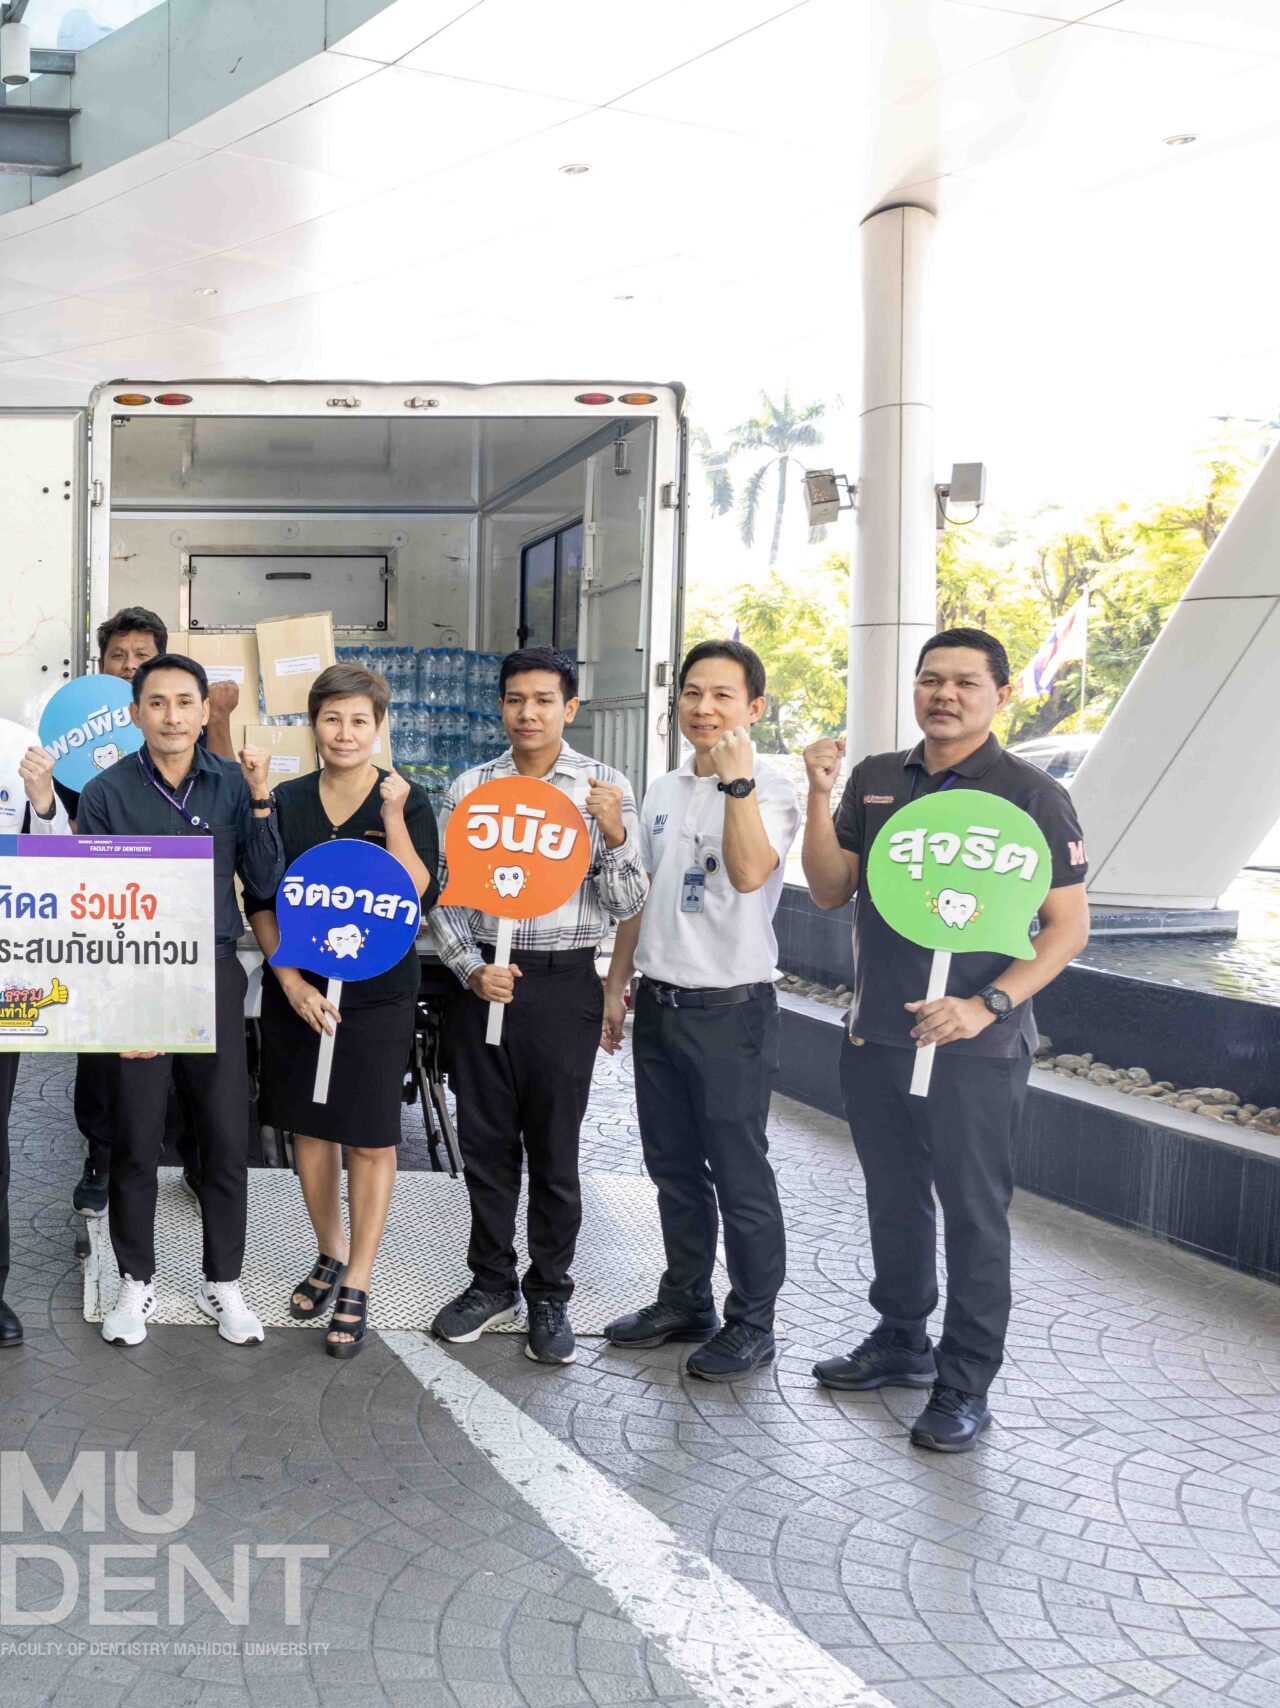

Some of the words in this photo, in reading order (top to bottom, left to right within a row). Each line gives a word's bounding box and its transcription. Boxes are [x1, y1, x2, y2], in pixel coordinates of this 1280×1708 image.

[467, 804, 578, 860] วินัย
[654, 814, 668, 826] MU
[888, 825, 1040, 881] สุจริต
[70, 881, 159, 921] ร่วมใจ
[282, 876, 418, 926] จิตอาสา
